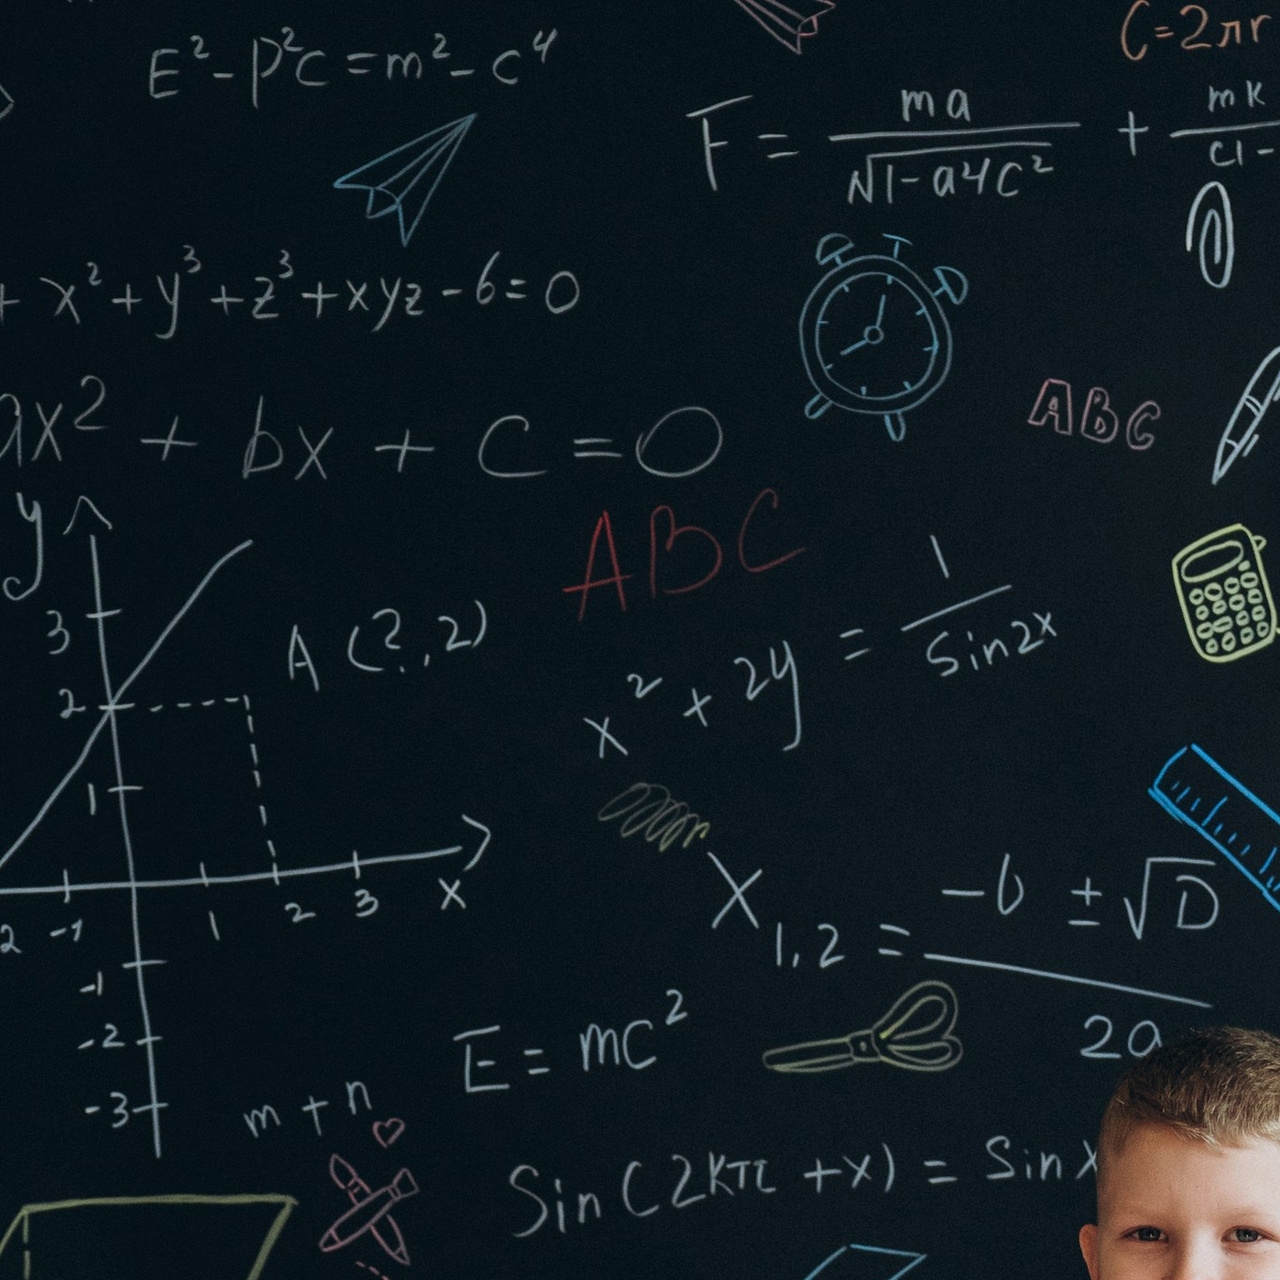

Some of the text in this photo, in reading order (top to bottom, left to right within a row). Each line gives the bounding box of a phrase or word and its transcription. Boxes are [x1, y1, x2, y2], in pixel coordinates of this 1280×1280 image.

[685, 94, 753, 192] F
[1026, 377, 1162, 451] ABC
[563, 488, 805, 622] ABC
